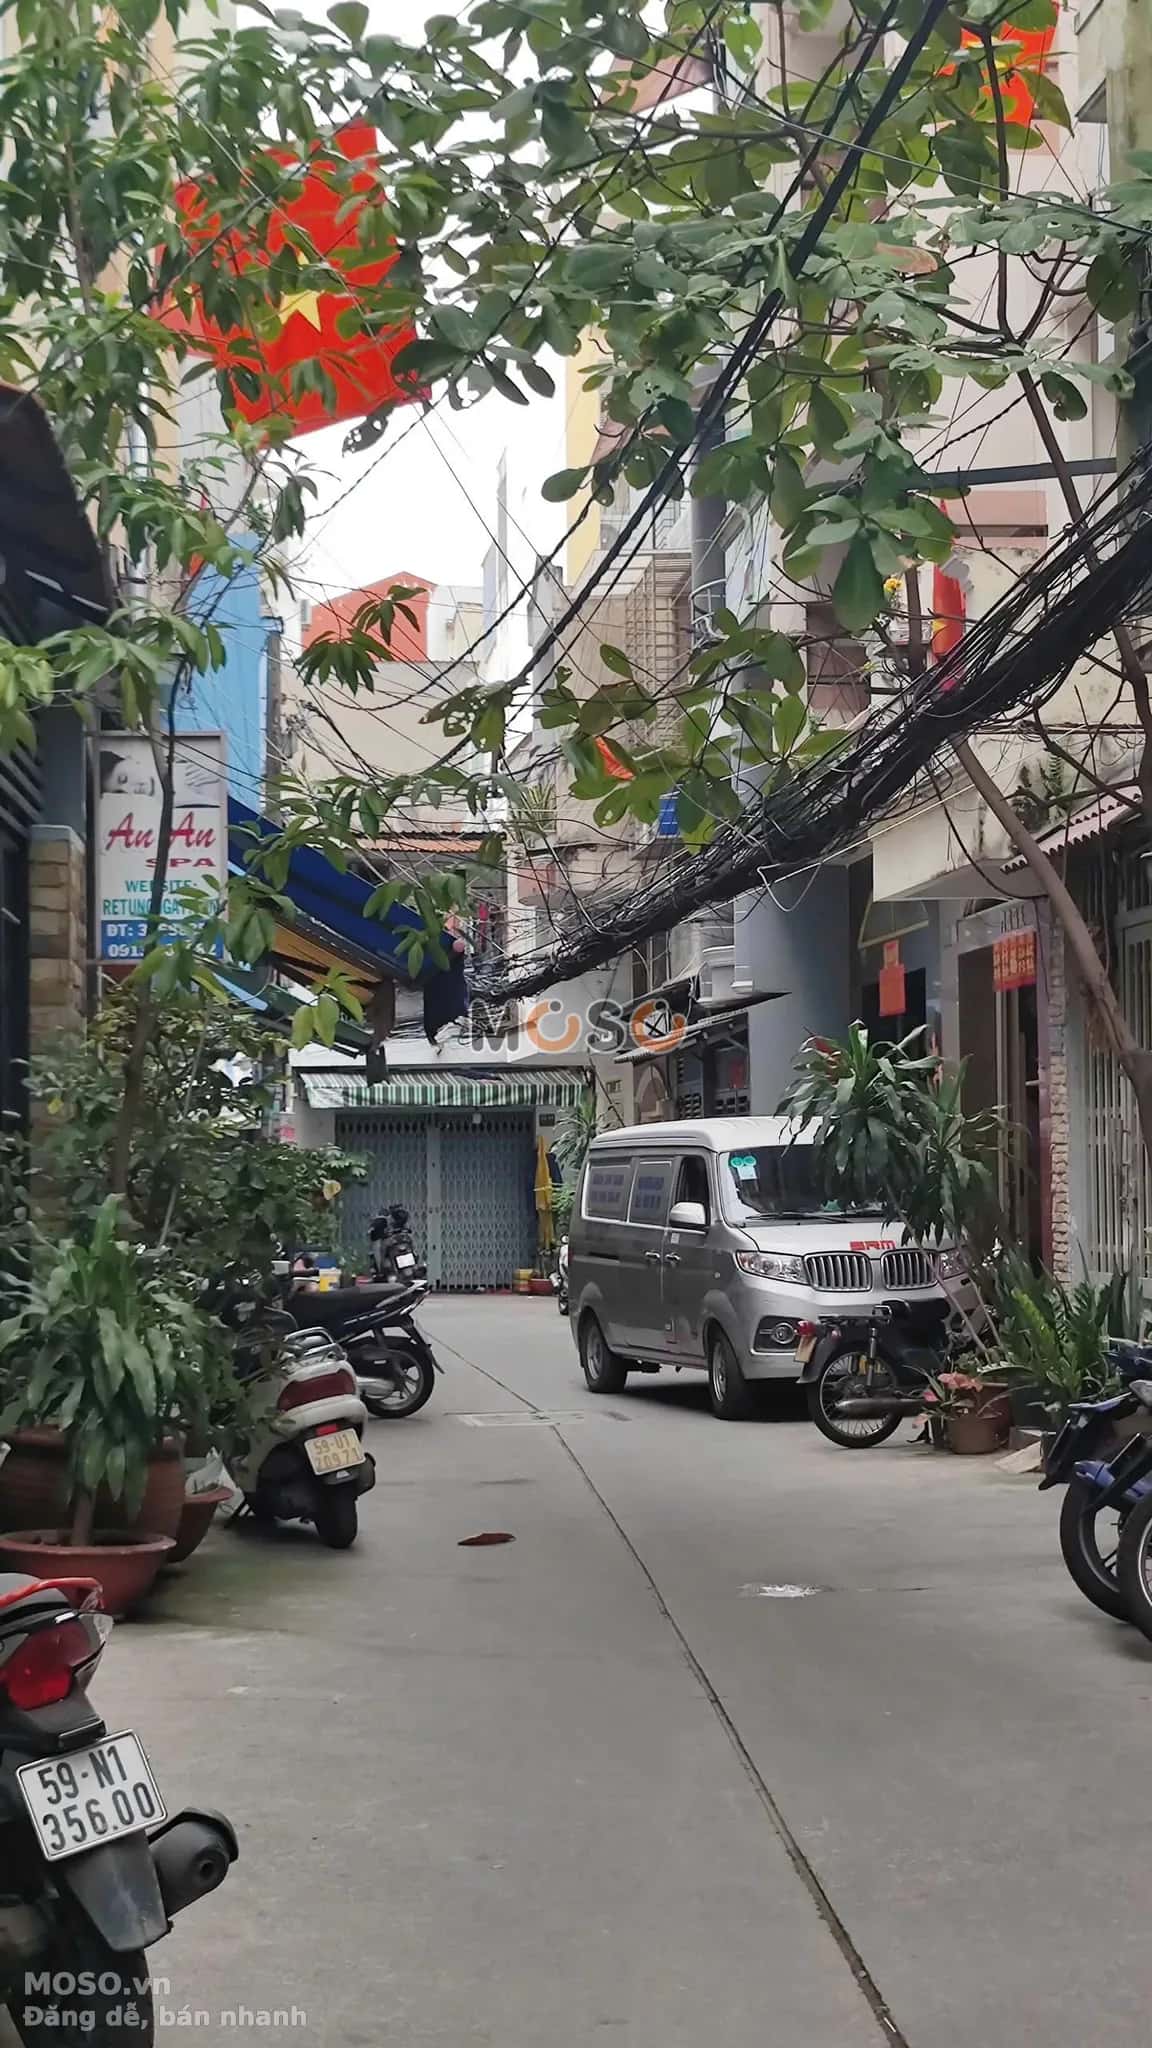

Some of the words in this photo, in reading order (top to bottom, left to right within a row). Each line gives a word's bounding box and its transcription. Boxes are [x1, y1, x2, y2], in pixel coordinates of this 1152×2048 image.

[104, 811, 155, 850] An
[167, 810, 217, 849] An
[144, 857, 217, 868] SPA
[125, 879, 198, 894] WESITE:
[37, 1745, 128, 1805] 59-N1
[42, 1781, 156, 1851] 356.00
